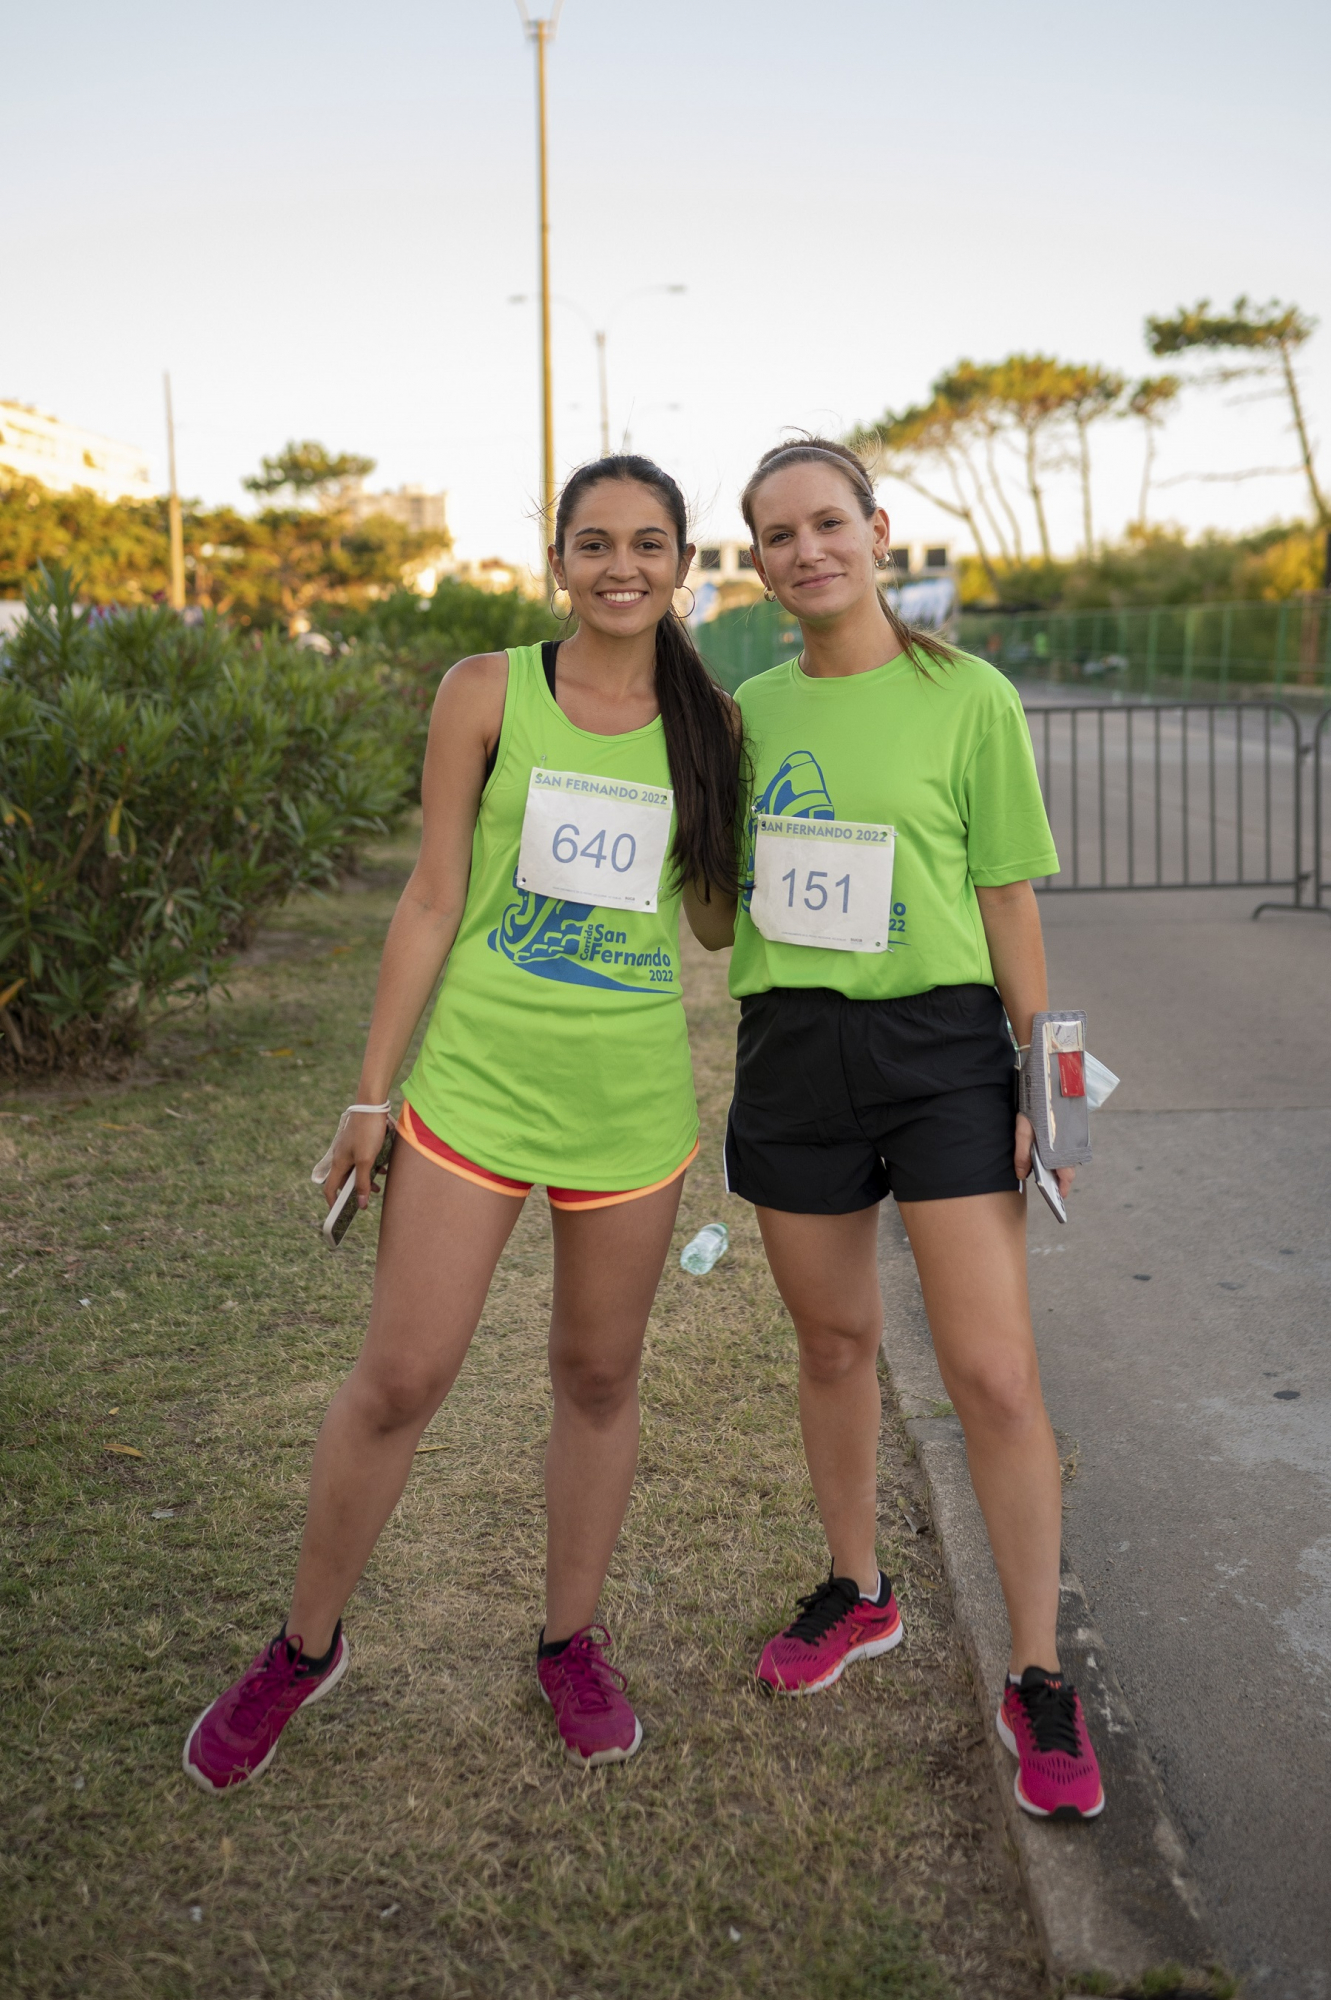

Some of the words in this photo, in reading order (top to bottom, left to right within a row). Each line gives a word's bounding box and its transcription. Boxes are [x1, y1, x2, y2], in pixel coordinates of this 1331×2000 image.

[535, 774, 562, 787] SAN
[566, 778, 638, 799] FERNANDO
[641, 791, 667, 805] 2022
[761, 820, 783, 833] SAN
[786, 823, 853, 839] FERNANDO
[856, 830, 887, 842] 2022
[552, 824, 636, 873] 640
[782, 868, 850, 914] 151
[594, 924, 627, 944] San
[889, 919, 906, 932] 22
[580, 924, 594, 961] Corrida
[589, 943, 671, 967] Fernando
[649, 970, 673, 982] 2022
